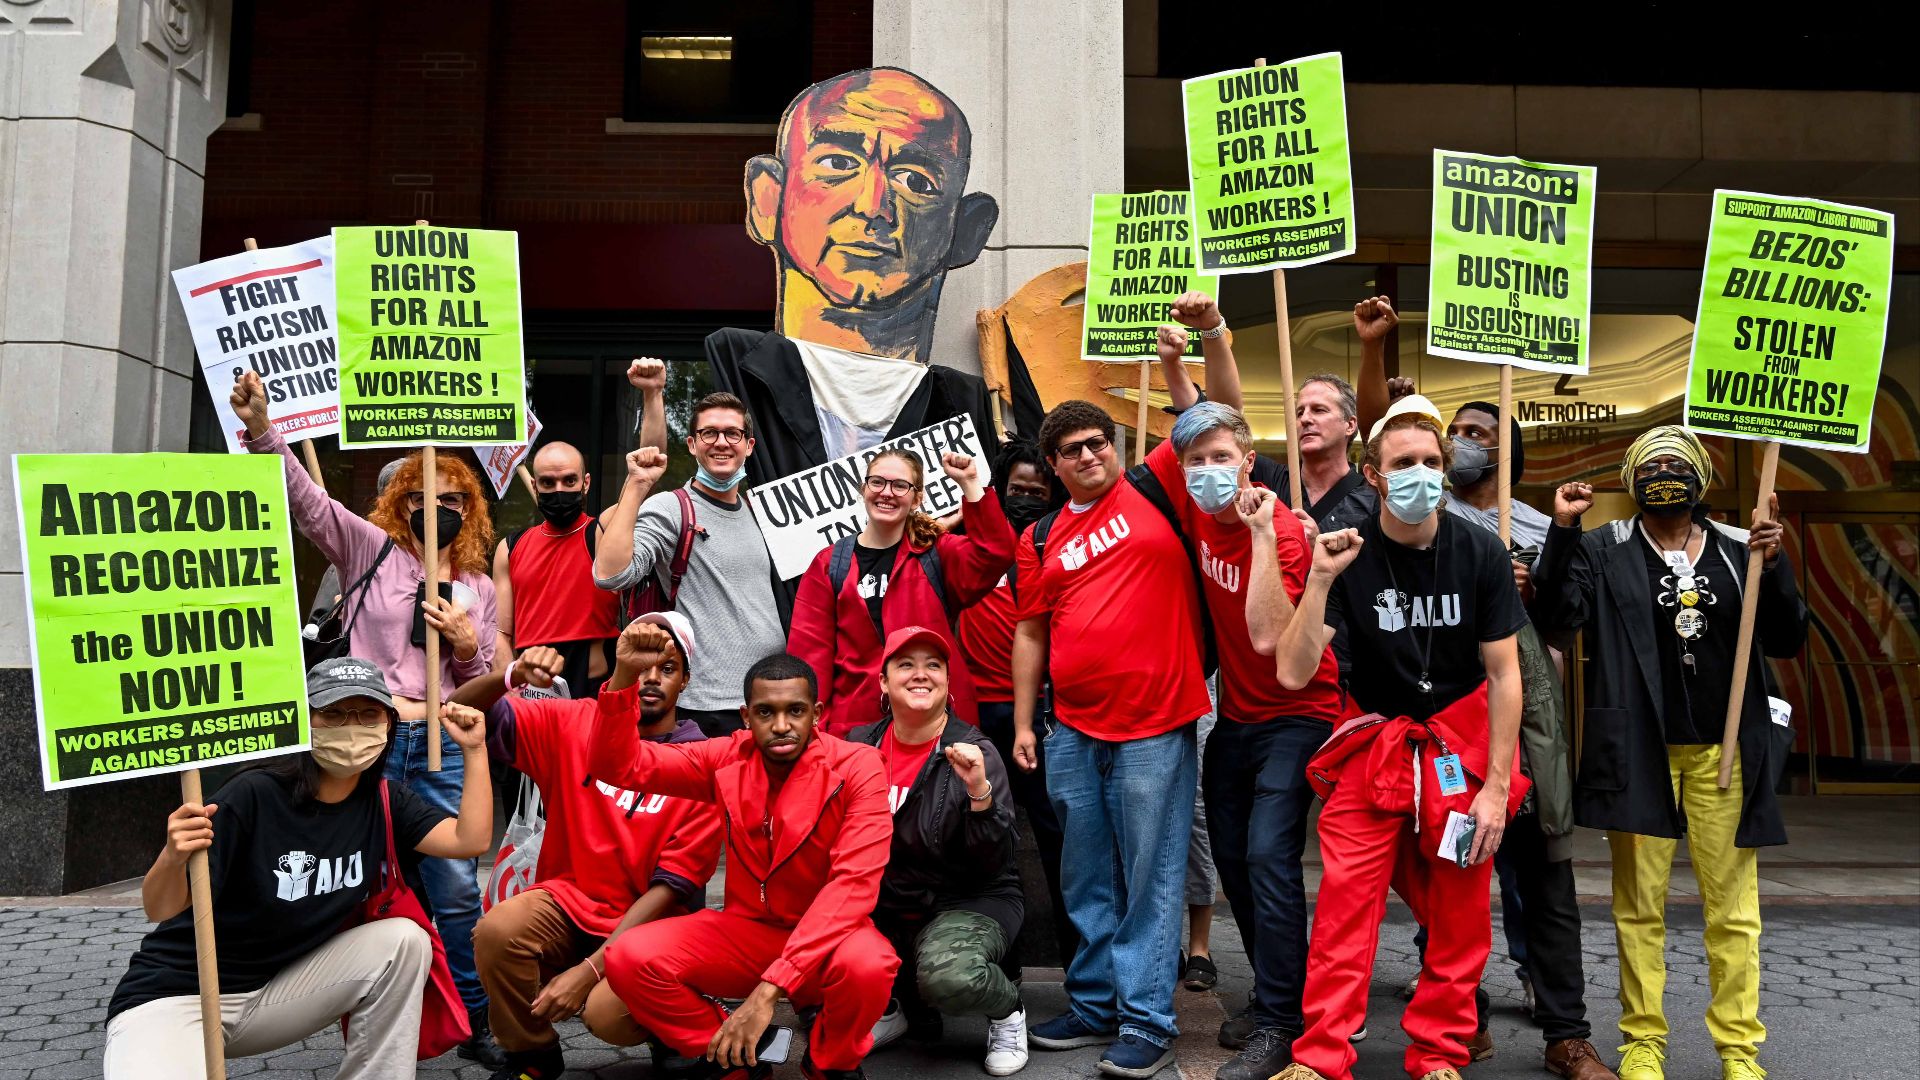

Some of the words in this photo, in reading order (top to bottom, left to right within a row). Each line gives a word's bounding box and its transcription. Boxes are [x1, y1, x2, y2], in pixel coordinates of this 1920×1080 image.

[1218, 66, 1298, 104] UNION
[1216, 98, 1306, 136] RIGHTS
[1218, 134, 1266, 167] FOR
[1275, 129, 1319, 158] ALL
[1220, 162, 1314, 197] AMAZON
[1447, 161, 1573, 196] amazon:
[1121, 194, 1186, 218] UNION
[1208, 195, 1316, 231] WORKERS
[1452, 192, 1566, 245] UNION
[1728, 201, 1770, 217] SUPPORT
[1773, 204, 1816, 222] AMAZON
[1817, 210, 1847, 226] LABOR
[1850, 216, 1877, 232] UNION
[375, 230, 468, 259] UNION
[1116, 220, 1188, 244] RIGHTS
[1204, 233, 1270, 252] WORKERS
[1274, 222, 1343, 243] ASSEMBLY
[1113, 248, 1150, 270] FOR
[1158, 247, 1194, 268] ALL
[1219, 248, 1275, 265] AGAINST
[1279, 241, 1330, 256] RACISM
[1749, 230, 1859, 270] BEZOS'
[372, 264, 476, 293] RIGHTS
[1110, 276, 1188, 296] AMAZON
[1457, 254, 1568, 299] BUSTING
[1722, 268, 1872, 313] BILLIONS:
[218, 276, 300, 316] FIGHT
[1508, 292, 1519, 308] IS
[371, 298, 427, 326] FOR
[438, 300, 488, 328] ALL
[1097, 302, 1173, 323] WORKER
[1445, 302, 1580, 342] DISGUSTING!
[217, 305, 328, 353] RACISM
[1090, 331, 1144, 340] WORKERS
[1147, 331, 1203, 340] ASBLY
[1434, 328, 1477, 342] Workers
[1481, 334, 1530, 349] Assembly
[1734, 316, 1836, 360] STOLEN
[248, 337, 336, 377] UNION
[370, 336, 481, 362] AMAZON
[1100, 344, 1146, 353] AGAINST
[1434, 337, 1473, 350] Against
[1476, 342, 1515, 354] Racism
[1763, 354, 1800, 376] FROM
[262, 368, 338, 405] STING
[354, 372, 482, 397] WORKERS
[1706, 369, 1849, 417] WORKERS!
[274, 417, 307, 432] RKERS
[306, 411, 338, 426] WORLD
[348, 408, 428, 422] WORKERS
[432, 408, 512, 420] ASSEMBLY
[1518, 401, 1617, 422] METROTECH
[1689, 410, 1730, 422] WORKERS
[1732, 414, 1781, 427] ASSEMBLY
[1783, 420, 1820, 432] AGAINST
[1822, 425, 1855, 436] RACISM
[366, 425, 432, 438] AGAINST
[436, 424, 497, 436] RACISM
[1536, 425, 1600, 445] CENTER
[1736, 424, 1759, 433] Insta:
[40, 484, 270, 536] Amazon:
[1088, 514, 1130, 557] ALU
[51, 547, 280, 597] RECOGNIZE
[1212, 557, 1240, 592] ALU
[1411, 594, 1461, 626] ALU
[72, 632, 132, 663] the
[142, 607, 273, 657] UNION
[120, 664, 220, 714] NOW
[60, 723, 184, 752] WORKERS
[191, 708, 295, 736] ASSEMBLY
[90, 746, 192, 774] AGAINST
[199, 734, 275, 760] RACISM
[314, 851, 363, 896] ALU
